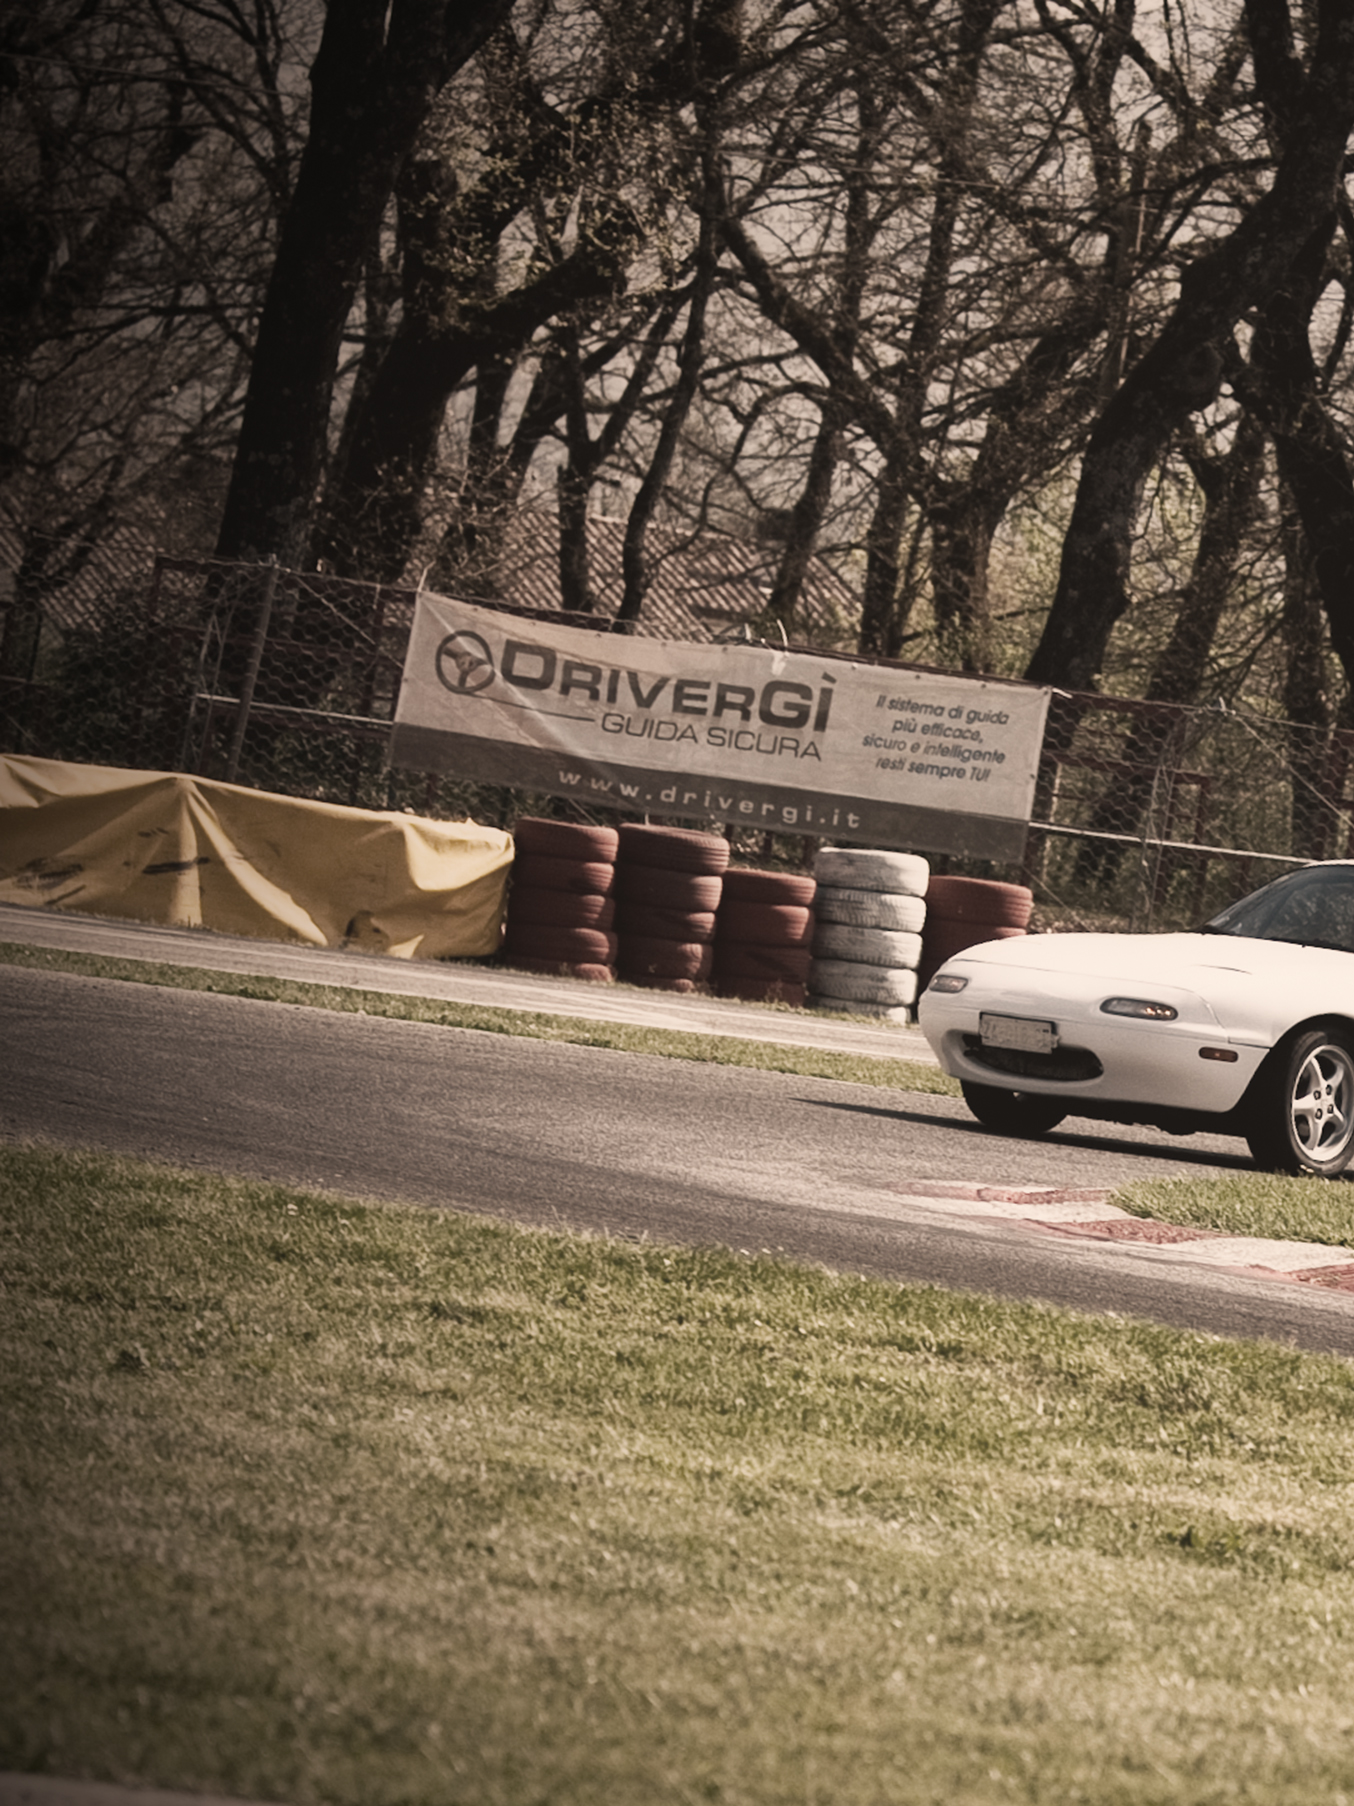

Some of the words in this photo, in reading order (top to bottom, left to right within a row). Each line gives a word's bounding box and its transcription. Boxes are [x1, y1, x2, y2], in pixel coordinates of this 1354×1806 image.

[887, 696, 946, 717] sistema
[947, 705, 965, 720] di
[965, 708, 1010, 725] guida
[891, 716, 917, 734] più
[600, 712, 699, 745] GUIDA
[706, 726, 823, 762] SICURA
[861, 733, 907, 752] sicuro
[910, 741, 921, 754] e
[923, 740, 1007, 765] intelligente
[875, 756, 907, 771] resti
[907, 760, 967, 780] sempre
[557, 769, 861, 829] www.drivergi.it
